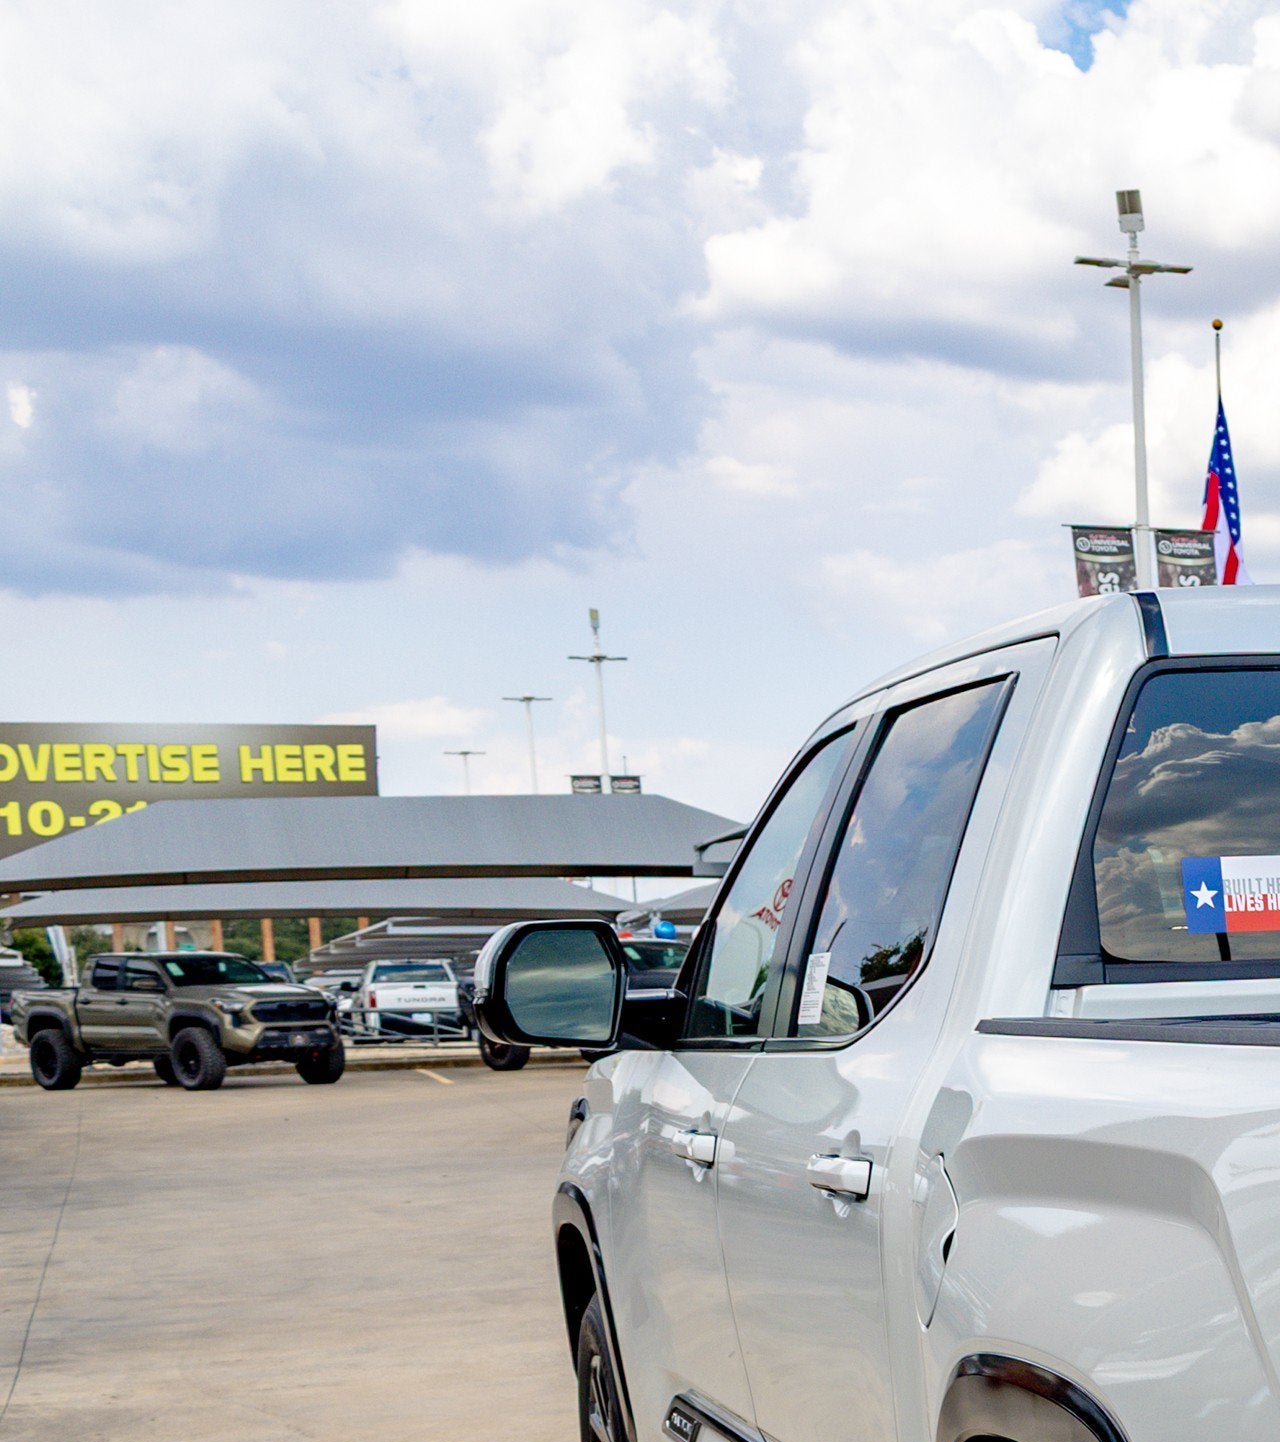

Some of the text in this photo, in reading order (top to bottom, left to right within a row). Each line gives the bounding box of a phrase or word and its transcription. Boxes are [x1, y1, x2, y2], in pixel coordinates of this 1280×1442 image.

[238, 744, 367, 782] HERE
[1223, 878, 1263, 894] BUILT
[1224, 893, 1265, 912] LIVES
